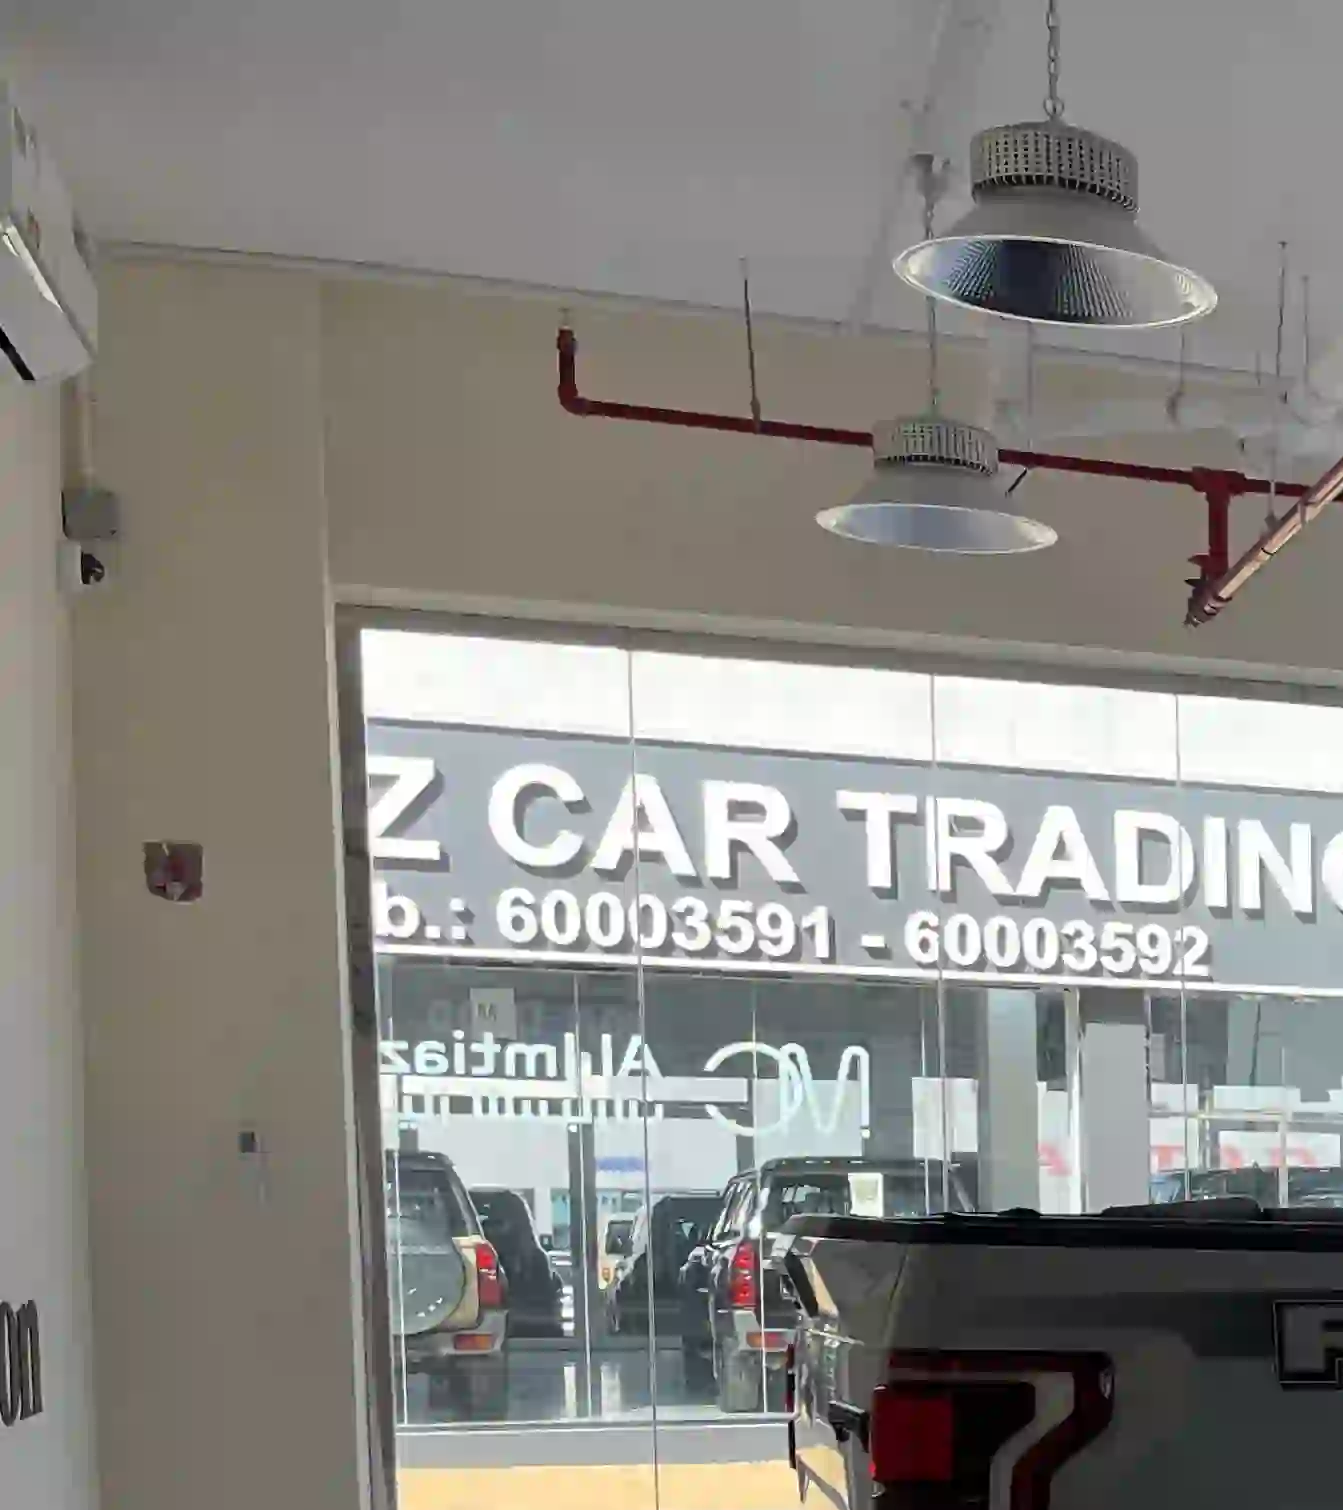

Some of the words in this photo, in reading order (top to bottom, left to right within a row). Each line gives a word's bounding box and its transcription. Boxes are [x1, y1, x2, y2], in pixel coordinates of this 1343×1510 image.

[488, 763, 802, 883] CAR
[496, 887, 830, 959] 60003591
[903, 909, 1211, 978] 60003592
